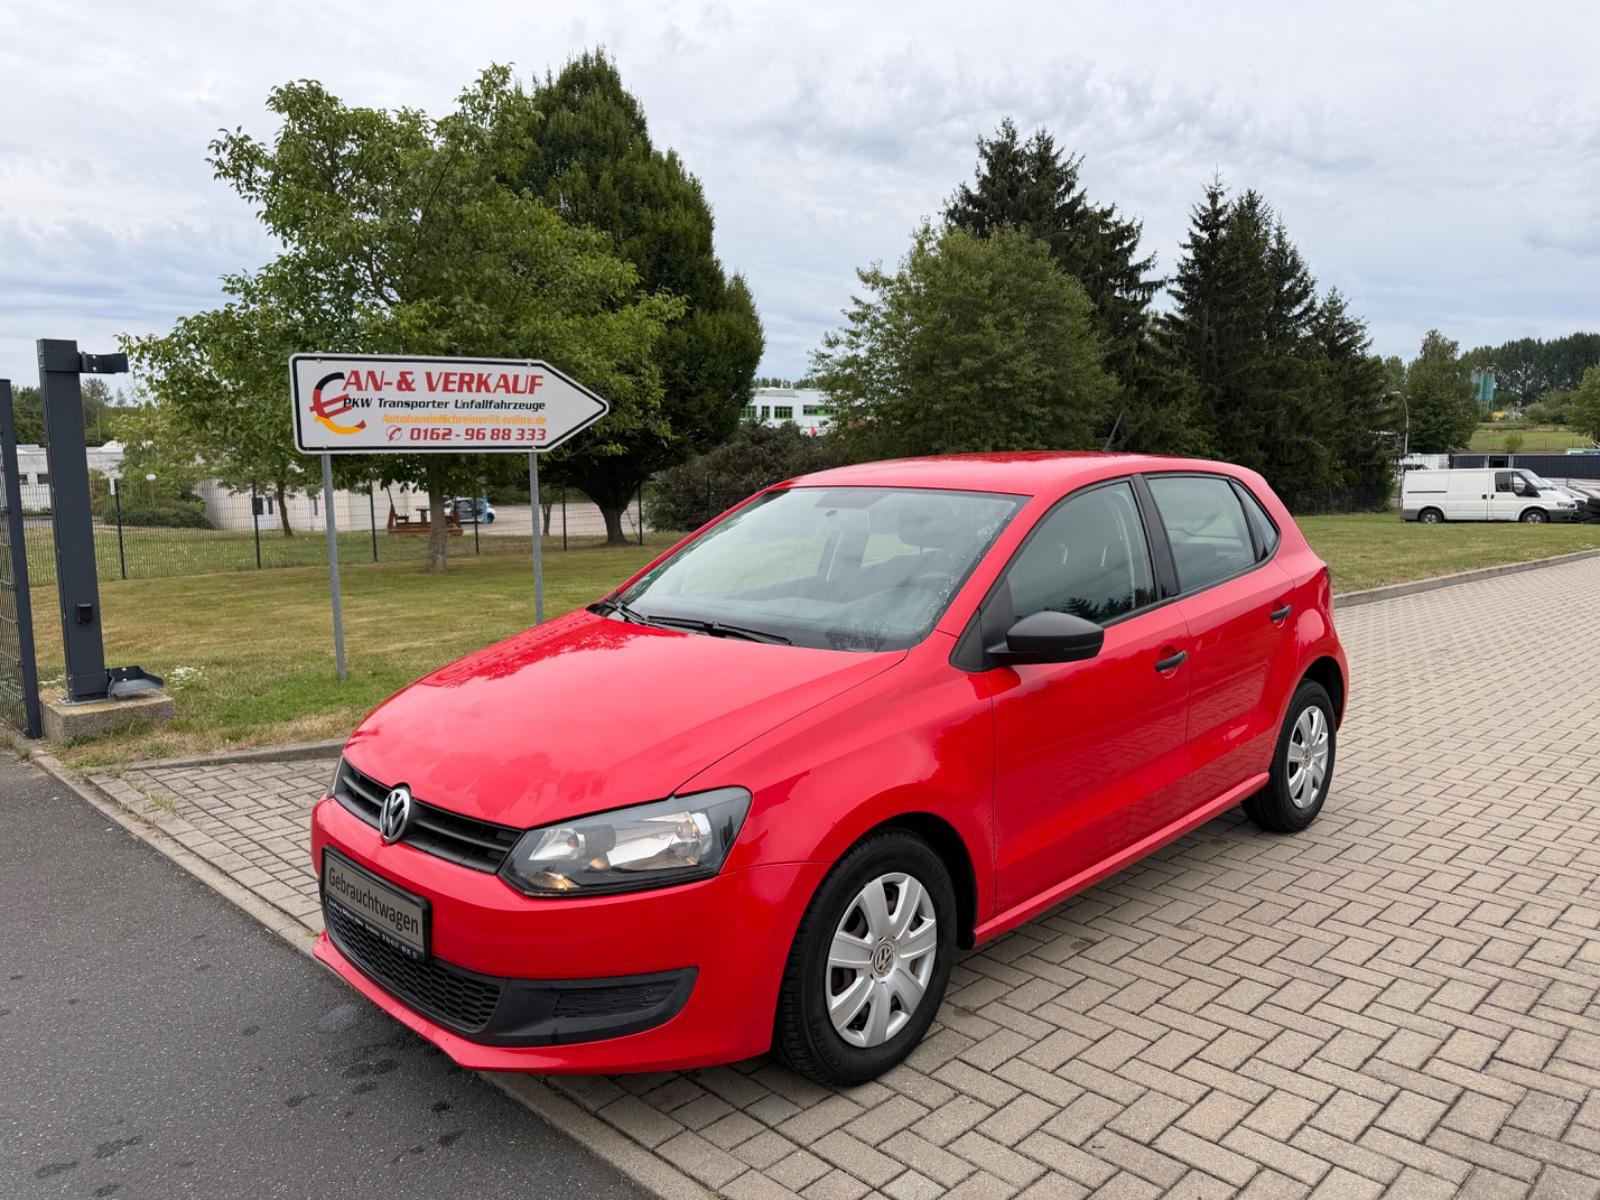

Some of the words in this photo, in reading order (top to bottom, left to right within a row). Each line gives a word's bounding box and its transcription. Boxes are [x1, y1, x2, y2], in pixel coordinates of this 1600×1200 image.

[396, 371, 415, 392] &
[425, 371, 544, 394] VERKAUF
[343, 397, 373, 409] PKW
[377, 398, 450, 410] Transporter
[454, 399, 546, 412] Unfallfahrzeuge
[490, 428, 512, 441] 88
[515, 428, 547, 441] 333
[328, 867, 419, 936] Gebrauchtwagen
